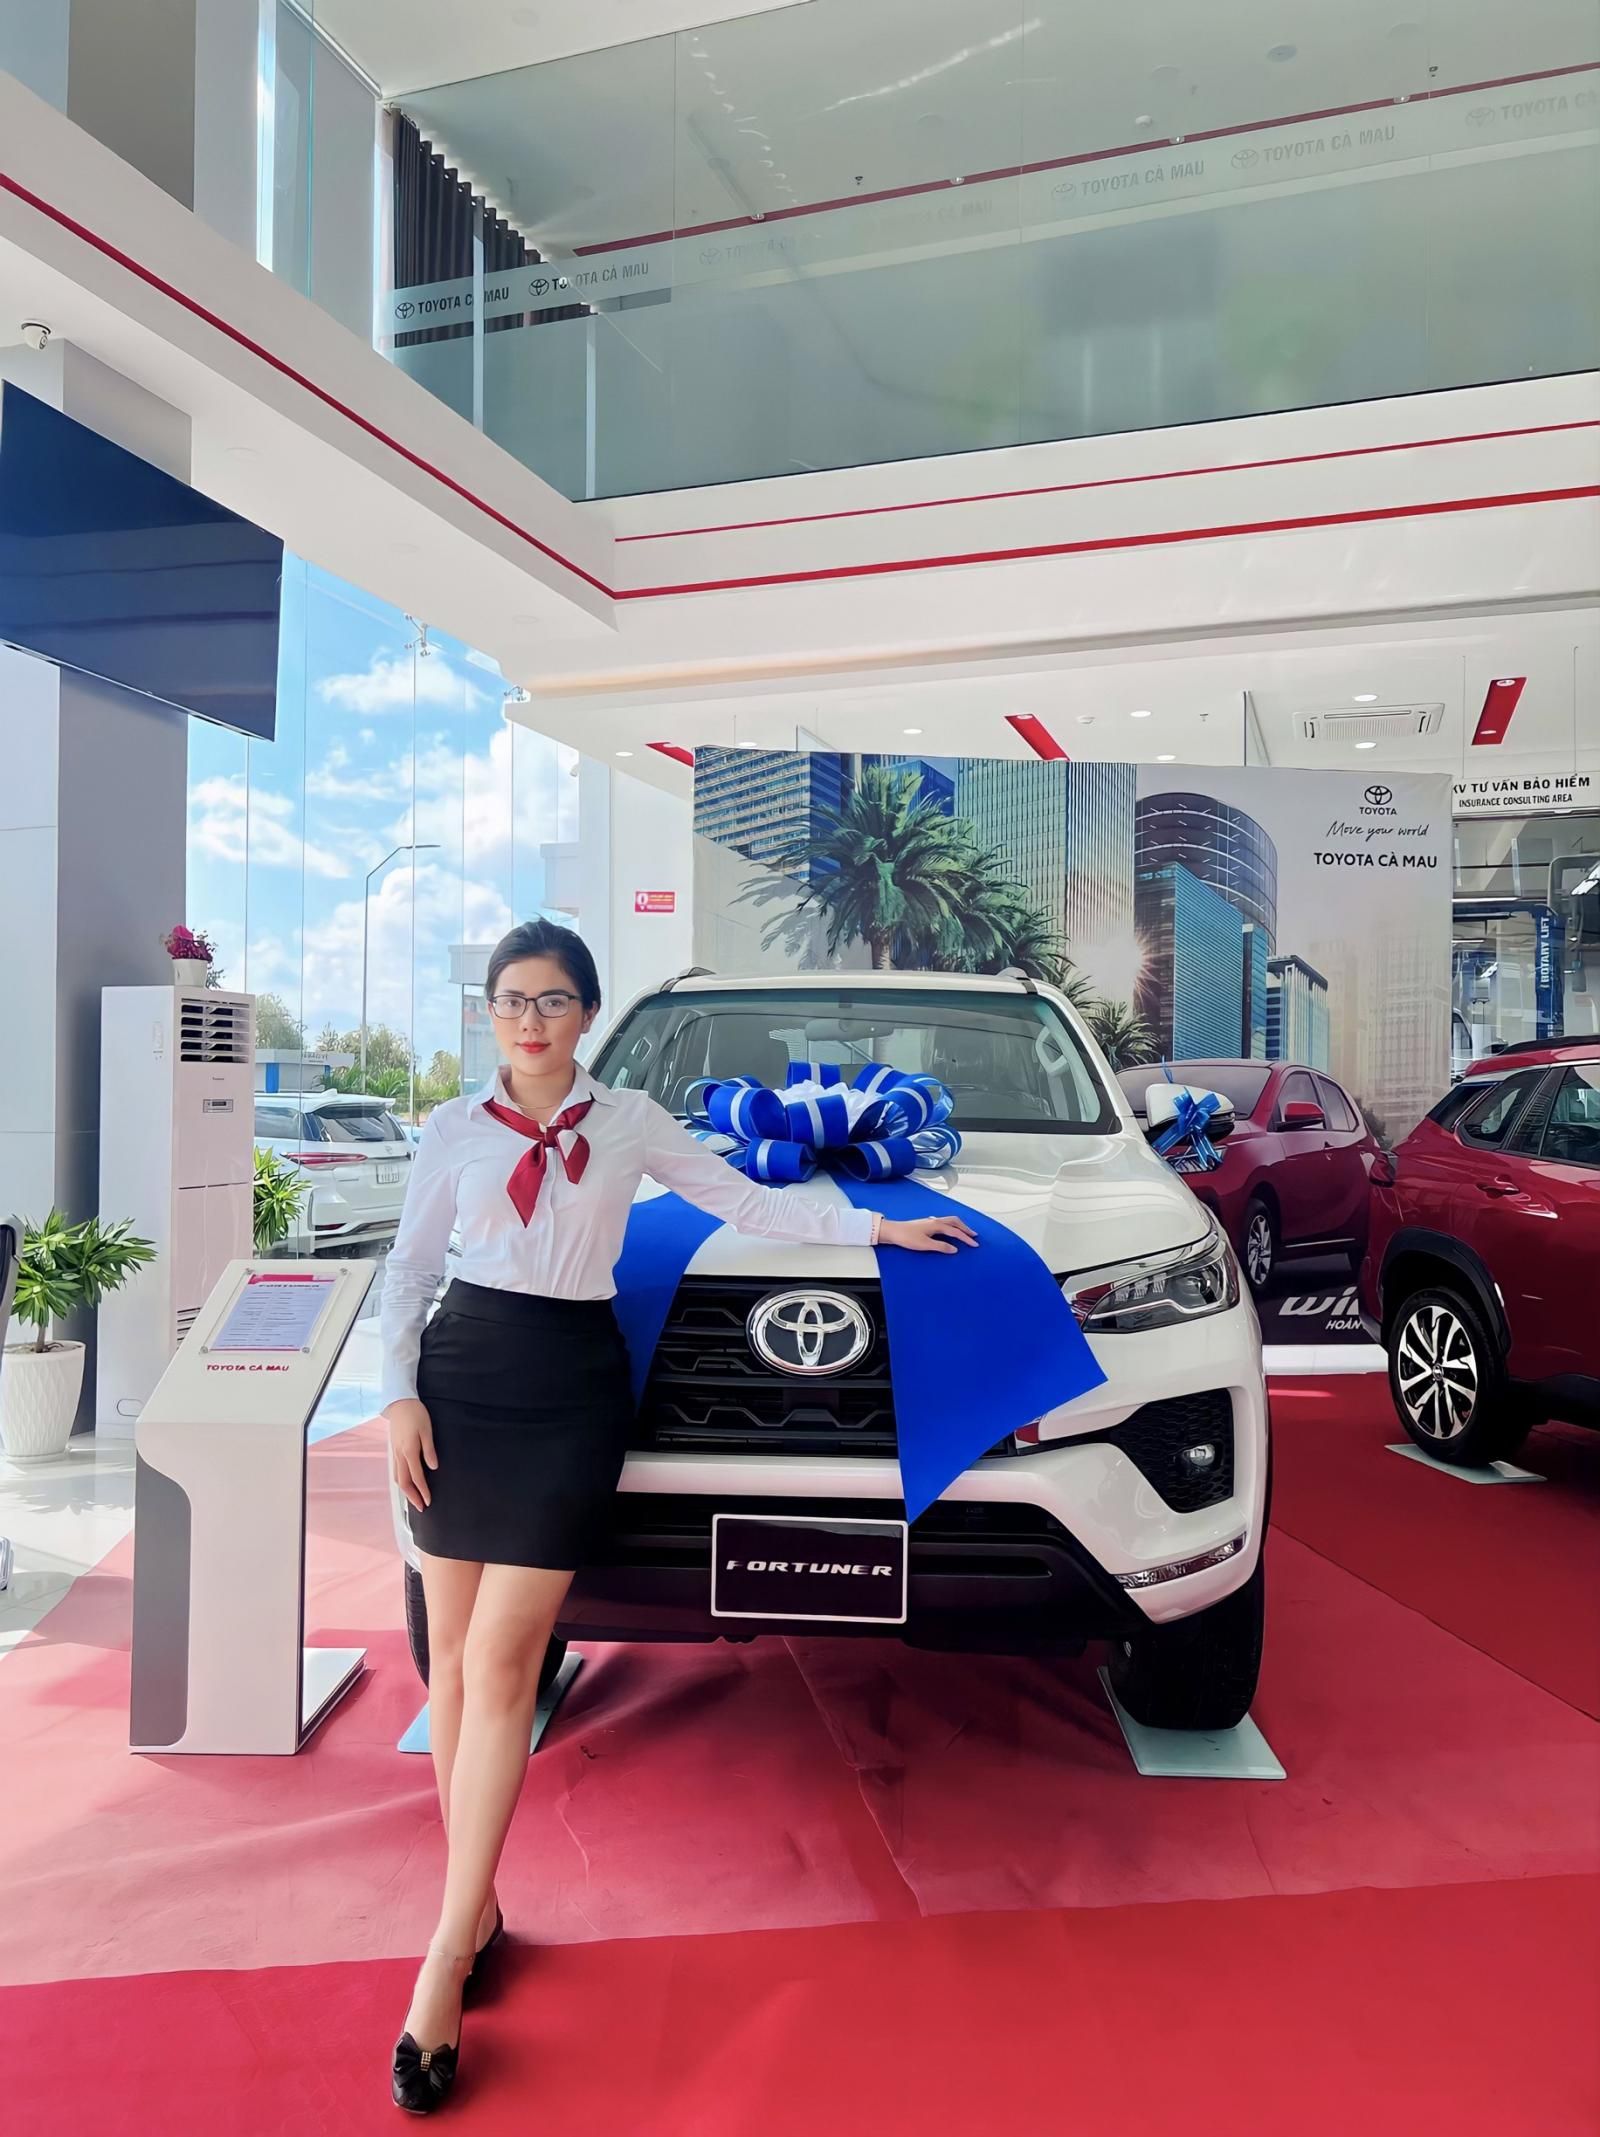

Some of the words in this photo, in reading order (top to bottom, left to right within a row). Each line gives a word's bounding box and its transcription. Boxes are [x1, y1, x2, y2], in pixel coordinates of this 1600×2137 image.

[1500, 96, 1568, 121] TOYOTA
[1263, 138, 1325, 163] TOYOTA
[1359, 125, 1395, 145] MAU
[1081, 172, 1139, 196] TOYOTA
[1171, 160, 1204, 180] MAU
[622, 262, 649, 279] MAU
[418, 295, 461, 315] TOYOTA
[484, 287, 509, 303] MAU
[1471, 781, 1489, 793] TƯ
[1492, 778, 1518, 792] VẤN
[1523, 776, 1550, 790] BẢO
[1555, 773, 1590, 788] HIỂM
[1360, 806, 1397, 816] TOYOTA
[1459, 797, 1501, 808] INSURANCE
[1503, 795, 1550, 806] CONSULTING
[1552, 793, 1573, 803] AREA
[1326, 820, 1364, 838] Move
[1365, 827, 1394, 842] your
[1398, 823, 1429, 837] world
[1314, 852, 1374, 866] TOYOTA
[1378, 851, 1398, 867] CÀ
[1402, 855, 1437, 868] MAU
[1540, 916, 1550, 938] LIFT
[726, 1560, 892, 1576] FORTUNER
